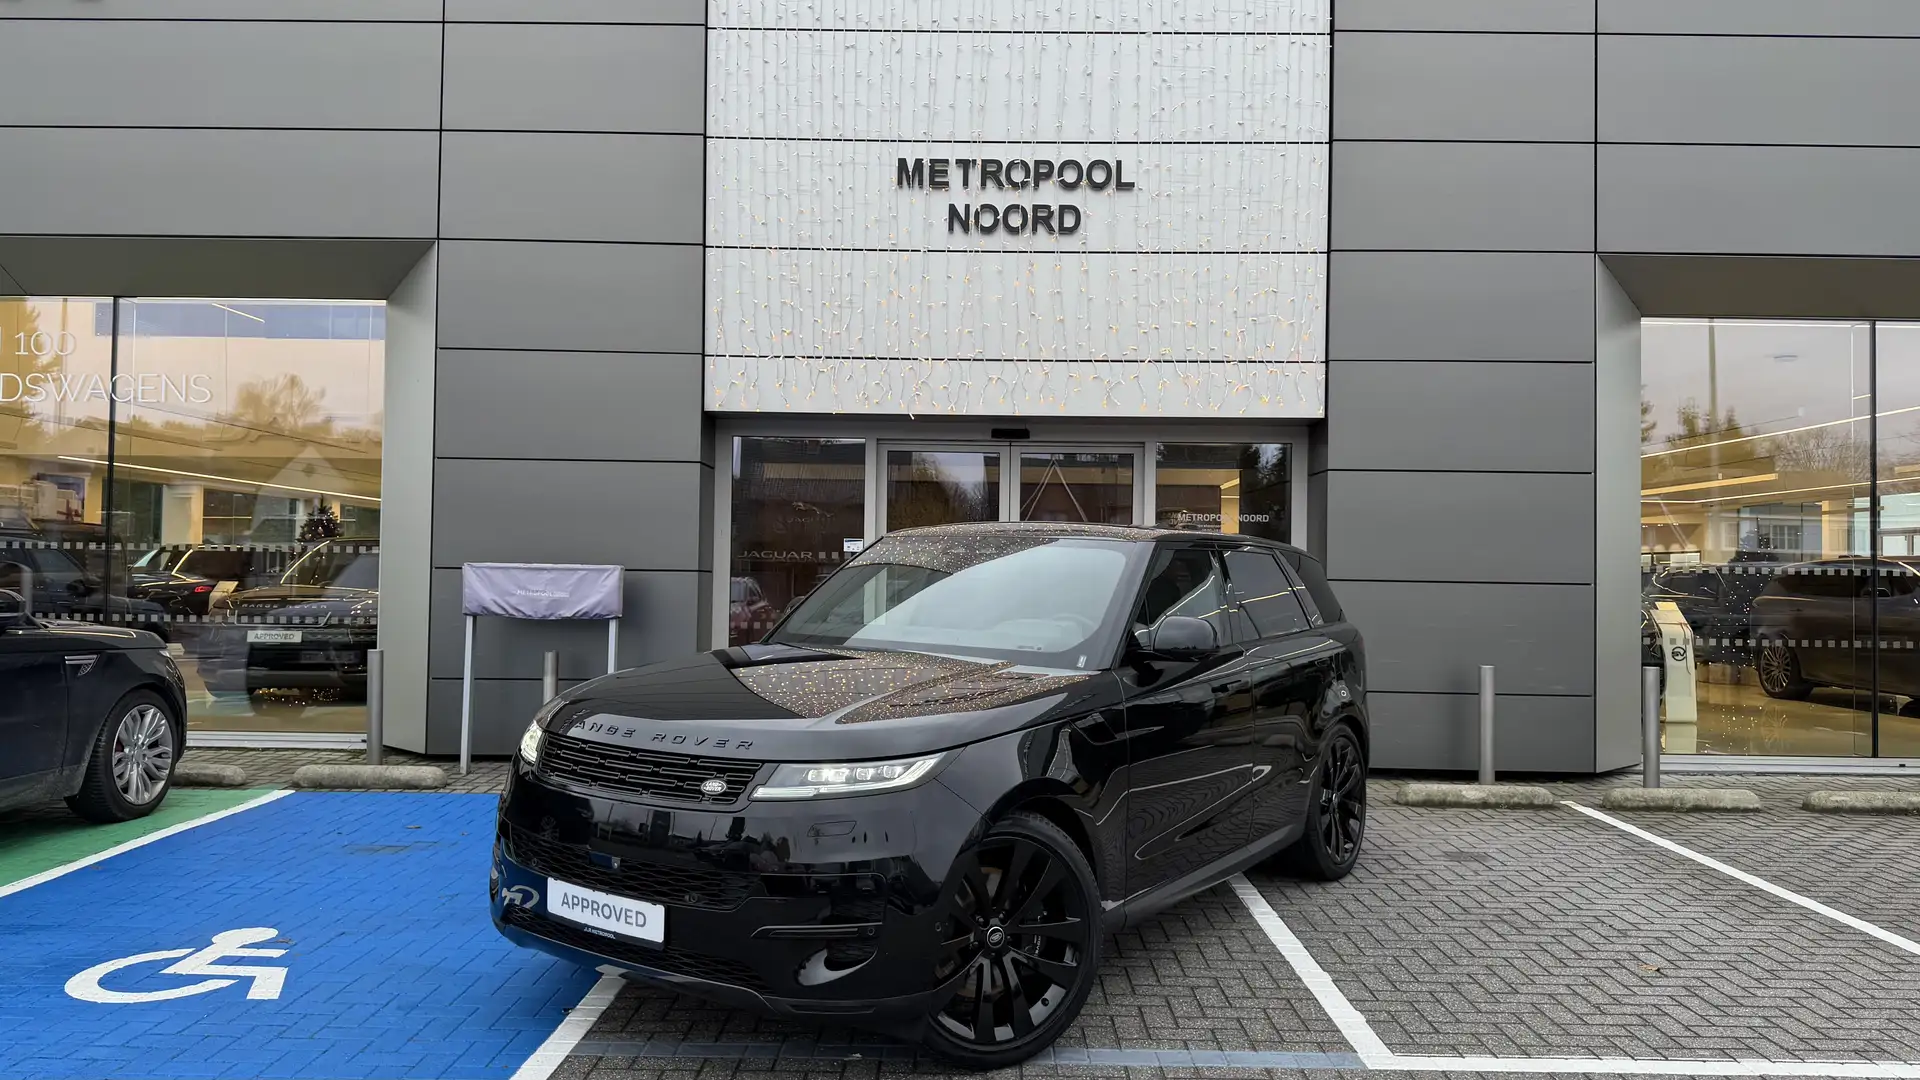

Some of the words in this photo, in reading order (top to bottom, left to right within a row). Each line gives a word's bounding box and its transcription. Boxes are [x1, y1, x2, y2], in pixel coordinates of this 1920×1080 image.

[897, 157, 1135, 189] METROPOOL
[948, 203, 1081, 234] NOORD
[14, 331, 77, 355] 100
[0, 373, 213, 403] DSWAGENS
[1177, 513, 1233, 522] METROPO
[738, 550, 812, 559] JAGUAR
[651, 732, 754, 751] ROVER
[561, 892, 647, 928] APPROVED
